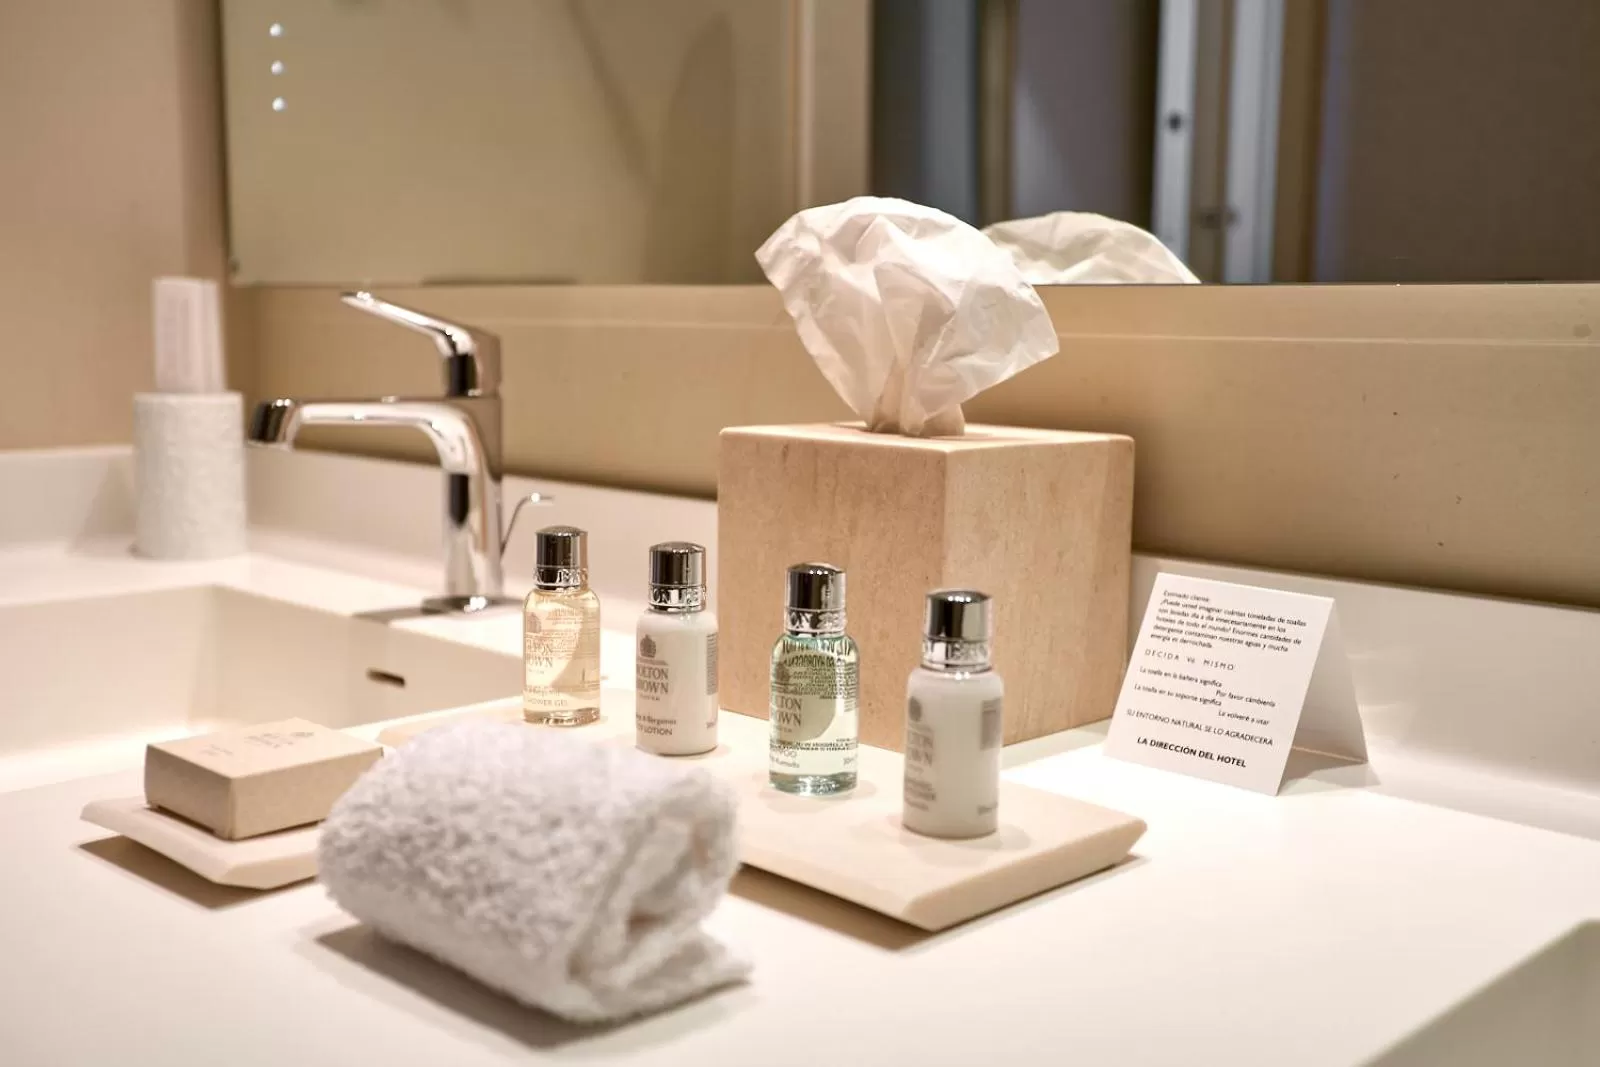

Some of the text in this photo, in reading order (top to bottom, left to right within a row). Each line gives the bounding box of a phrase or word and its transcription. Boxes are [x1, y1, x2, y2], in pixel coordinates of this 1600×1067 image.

[1199, 605, 1223, 613] imaginar
[1248, 612, 1276, 622] toneladas
[1216, 617, 1266, 630] innecesariamente
[1185, 630, 1218, 640] contaminan
[1219, 636, 1244, 645] nuestras
[1245, 640, 1261, 648] aguas
[1268, 644, 1288, 652] mucha
[1232, 627, 1258, 638] Enormes
[1260, 633, 1292, 643] cantidades
[1144, 648, 1180, 660] DECIDA
[1204, 659, 1234, 671] MISMO
[1140, 666, 1146, 674] La
[1148, 668, 1162, 676] toalla
[1200, 678, 1222, 688] significa
[1176, 693, 1198, 702] soporte
[1200, 698, 1222, 706] significa
[1216, 689, 1227, 697] Por
[1228, 692, 1244, 700] favor
[1127, 708, 1136, 717] SU
[1136, 710, 1170, 724] ENTORNO
[1171, 718, 1203, 732] NATURAL
[1204, 725, 1212, 733] SE
[1214, 728, 1224, 736] LO
[1137, 736, 1247, 768] LA DIRECCIÓN DEL HOTEL
